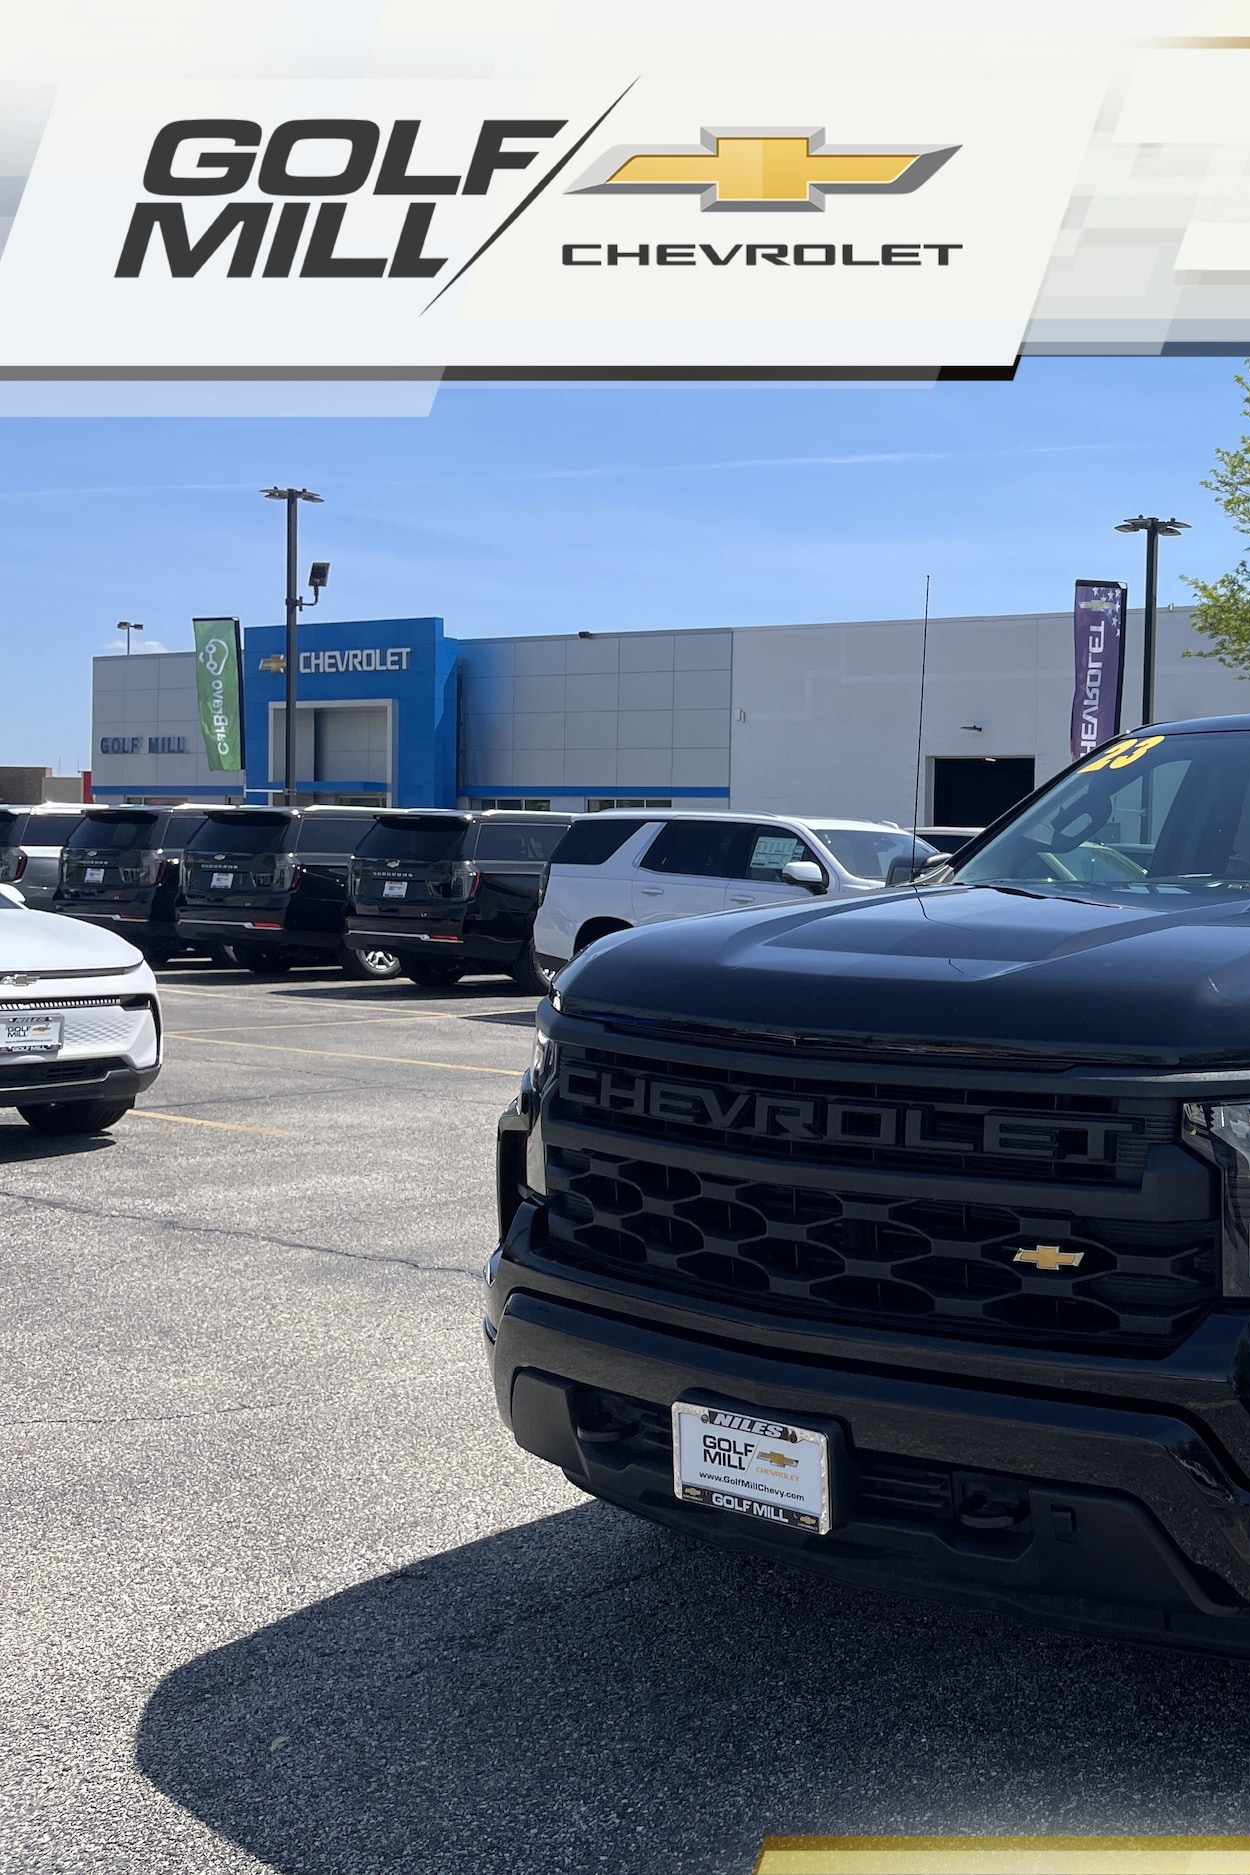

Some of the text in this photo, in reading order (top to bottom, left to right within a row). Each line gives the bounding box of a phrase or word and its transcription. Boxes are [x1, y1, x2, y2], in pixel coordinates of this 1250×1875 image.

[300, 648, 411, 673] CHEVROLET
[100, 736, 186, 754] GOLF MILL
[1077, 735, 1166, 774] 23
[559, 1066, 1140, 1161] CHEVROLET
[713, 1413, 784, 1439] NILES
[703, 1434, 755, 1457] GOLF
[703, 1449, 746, 1471] MILL
[699, 1471, 805, 1501] www.GolfMillChevy.com
[712, 1492, 789, 1523] GOLF MILL
